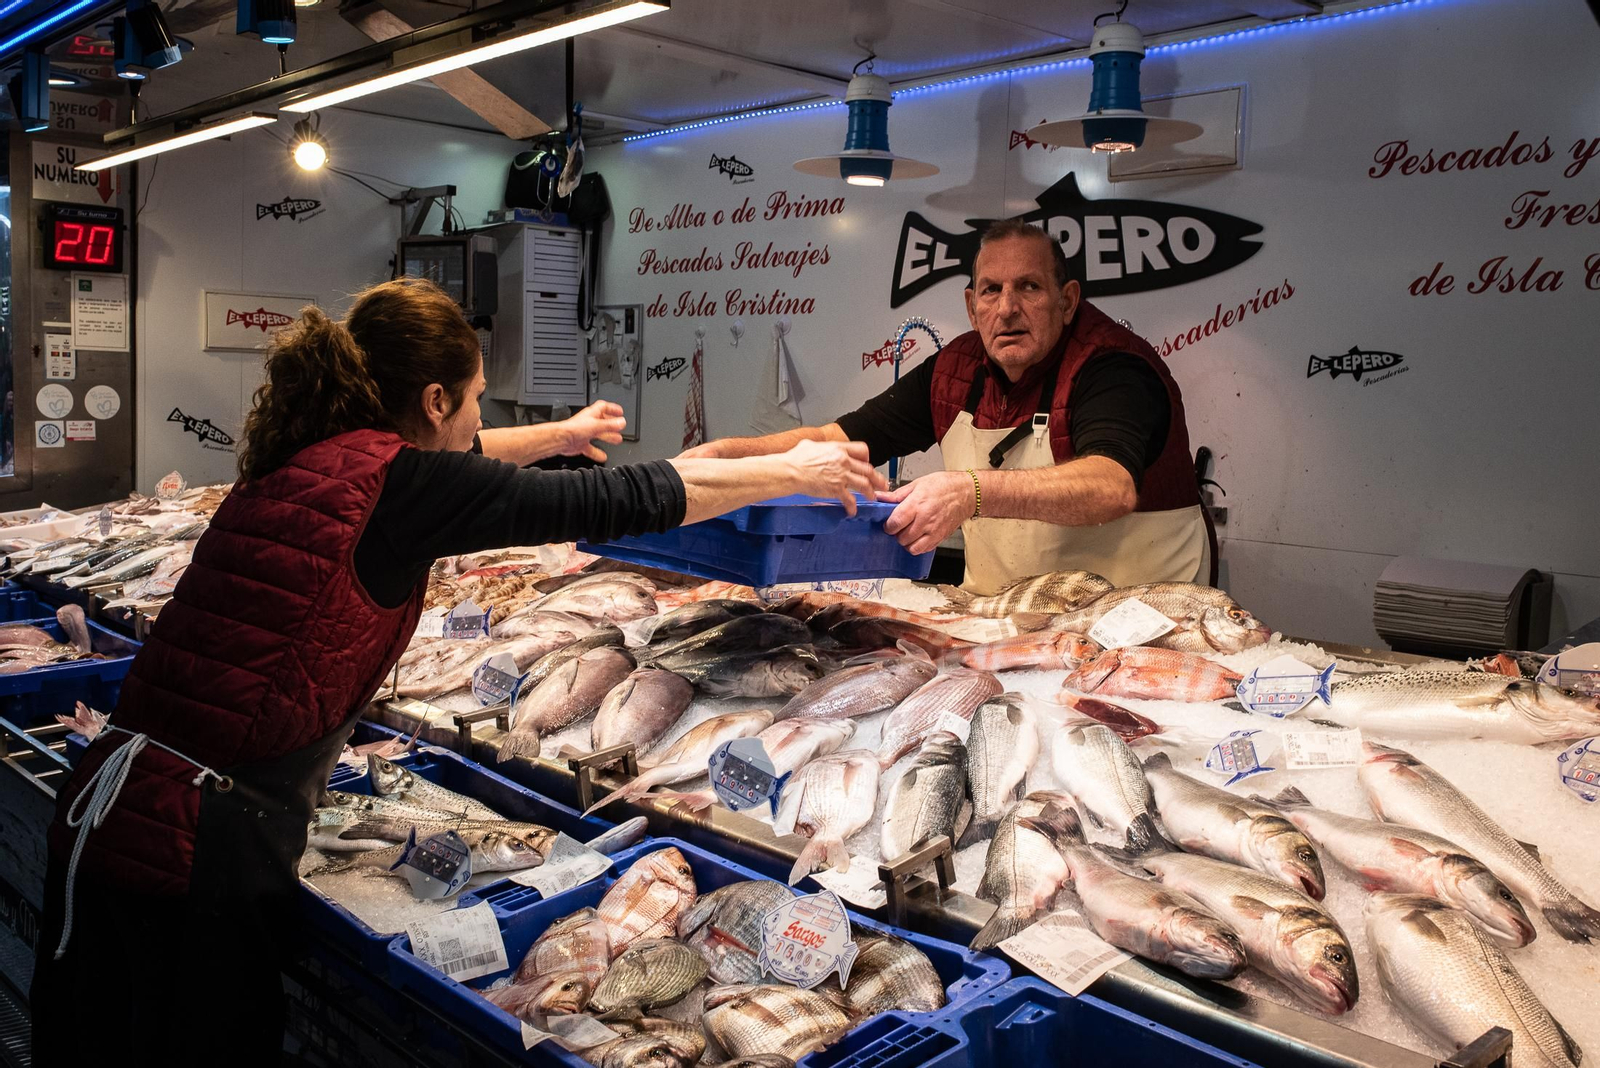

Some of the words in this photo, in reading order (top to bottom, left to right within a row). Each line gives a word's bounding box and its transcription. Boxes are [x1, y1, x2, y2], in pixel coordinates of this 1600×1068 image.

[57, 146, 75, 164] SU
[721, 160, 750, 175] LEPERO
[1368, 130, 1555, 179] Pescados
[34, 163, 99, 187] NUMERO
[274, 200, 316, 214] LEPERO
[628, 207, 654, 233] De
[656, 203, 706, 230] Alba
[713, 211, 725, 226] o
[731, 197, 756, 225] de
[763, 190, 846, 221] Prima
[55, 223, 114, 264] 20
[898, 226, 961, 290] EL
[1041, 214, 1217, 282] PERO
[637, 247, 724, 275] Pescados
[730, 242, 832, 278] Salvajes
[1407, 262, 1456, 296] de
[1467, 256, 1564, 295] Isla
[646, 293, 669, 318] de
[672, 290, 717, 318] Isla
[724, 288, 816, 317] Cristina
[246, 313, 289, 325] LEPERO
[1149, 278, 1296, 358] escaderías
[876, 340, 912, 360] LEPO
[1310, 357, 1329, 373] EL
[1333, 353, 1394, 371] LEPERO
[657, 359, 683, 374] LEPERO
[169, 410, 185, 422] EL
[188, 420, 230, 444] LEPERO
[783, 920, 827, 949] Sargos
